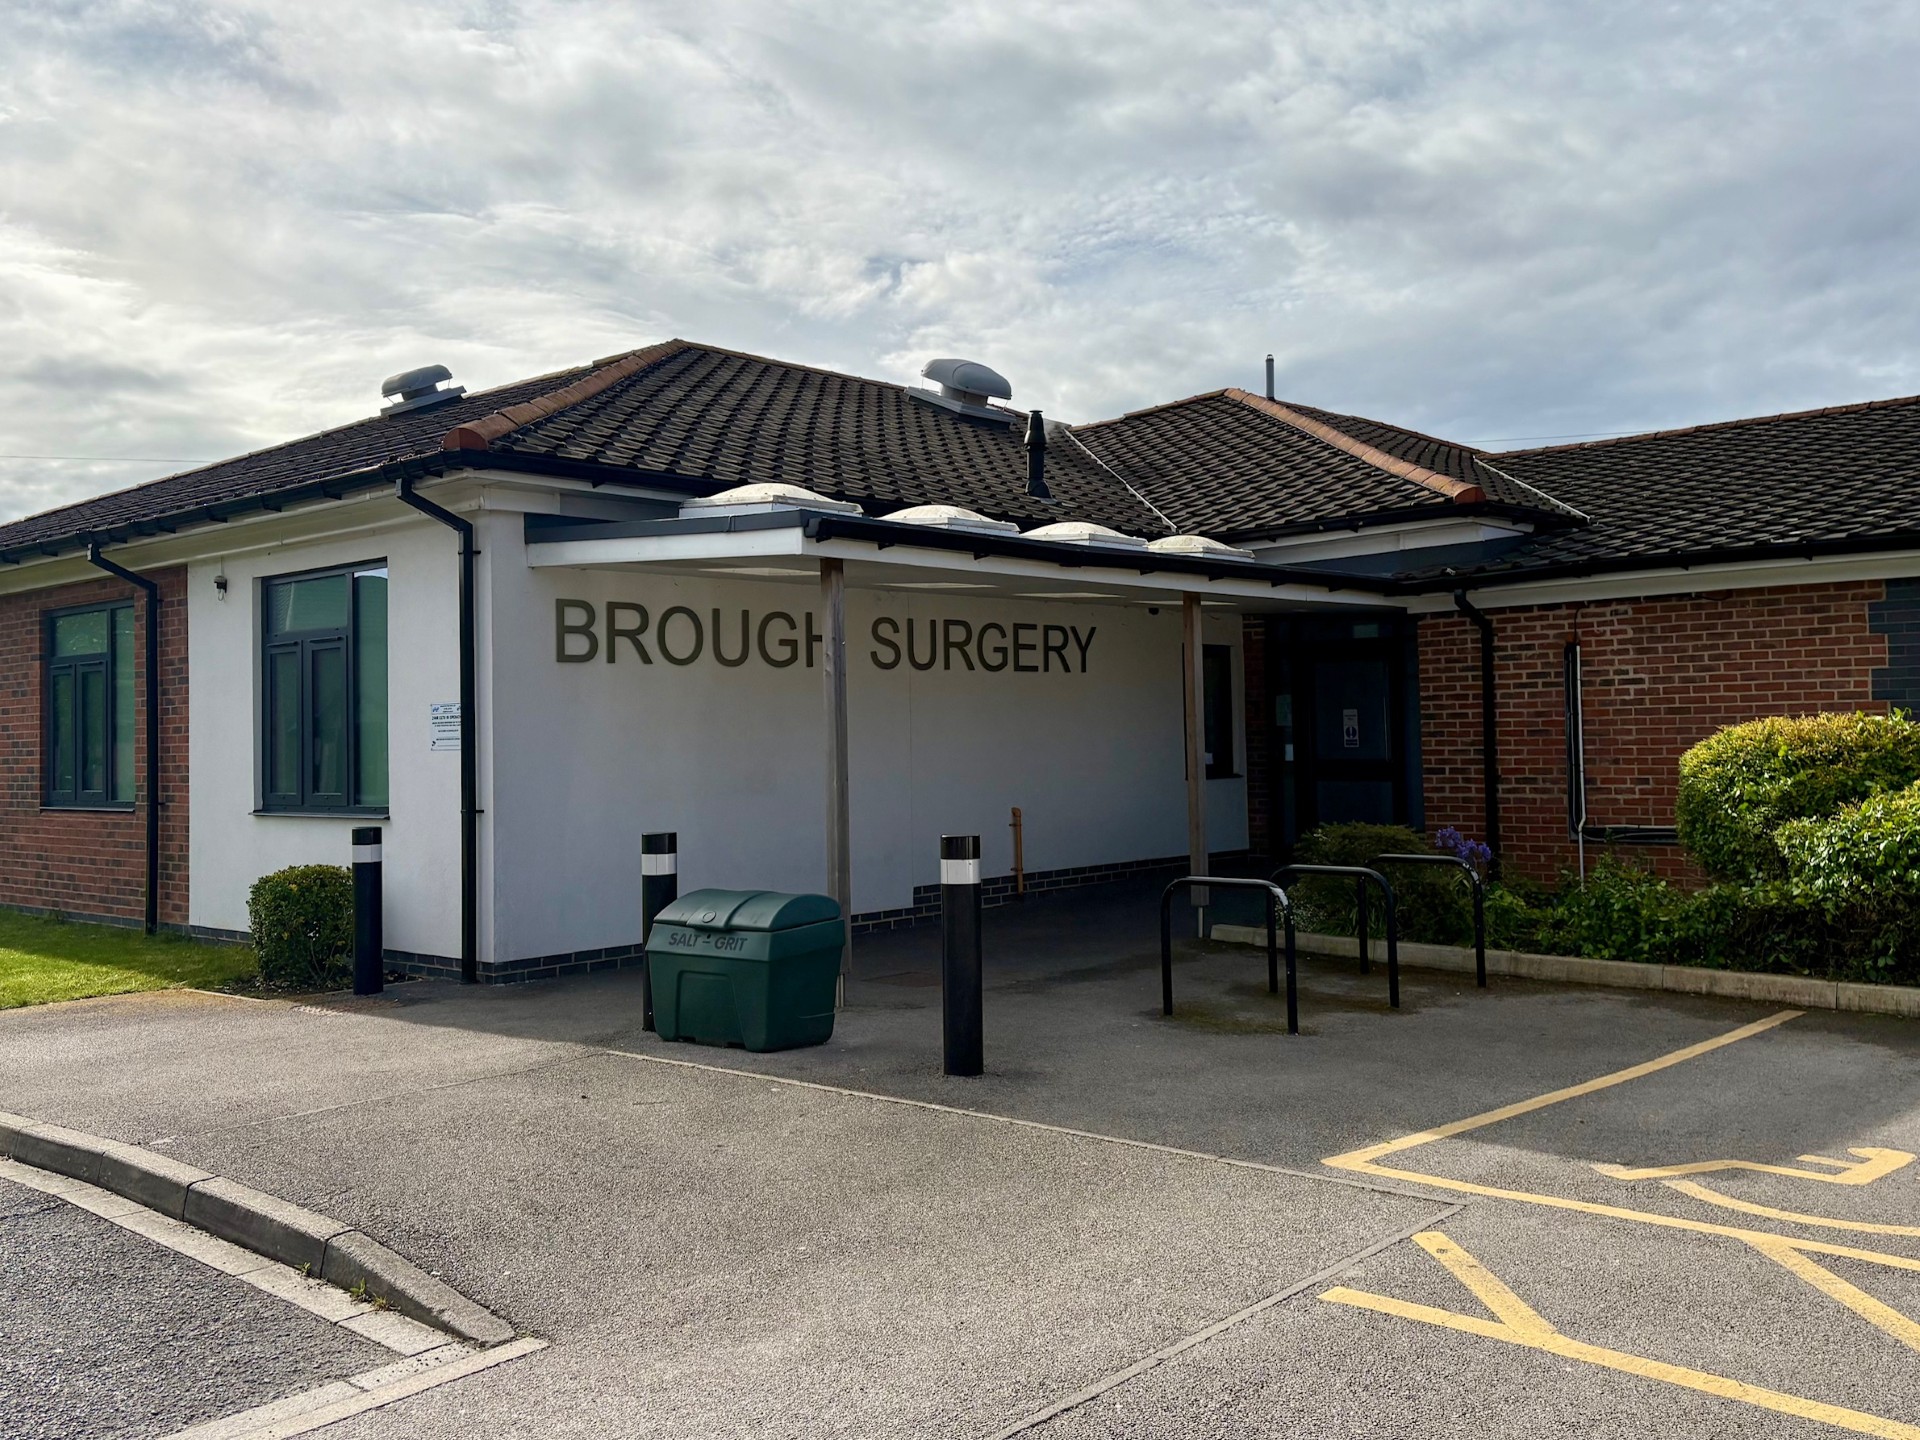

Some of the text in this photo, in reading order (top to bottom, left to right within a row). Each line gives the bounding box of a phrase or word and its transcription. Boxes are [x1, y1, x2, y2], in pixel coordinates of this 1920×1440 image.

[870, 617, 1097, 673] SURGERY
[668, 933, 701, 947] SALT
[714, 937, 748, 951] GRIT
